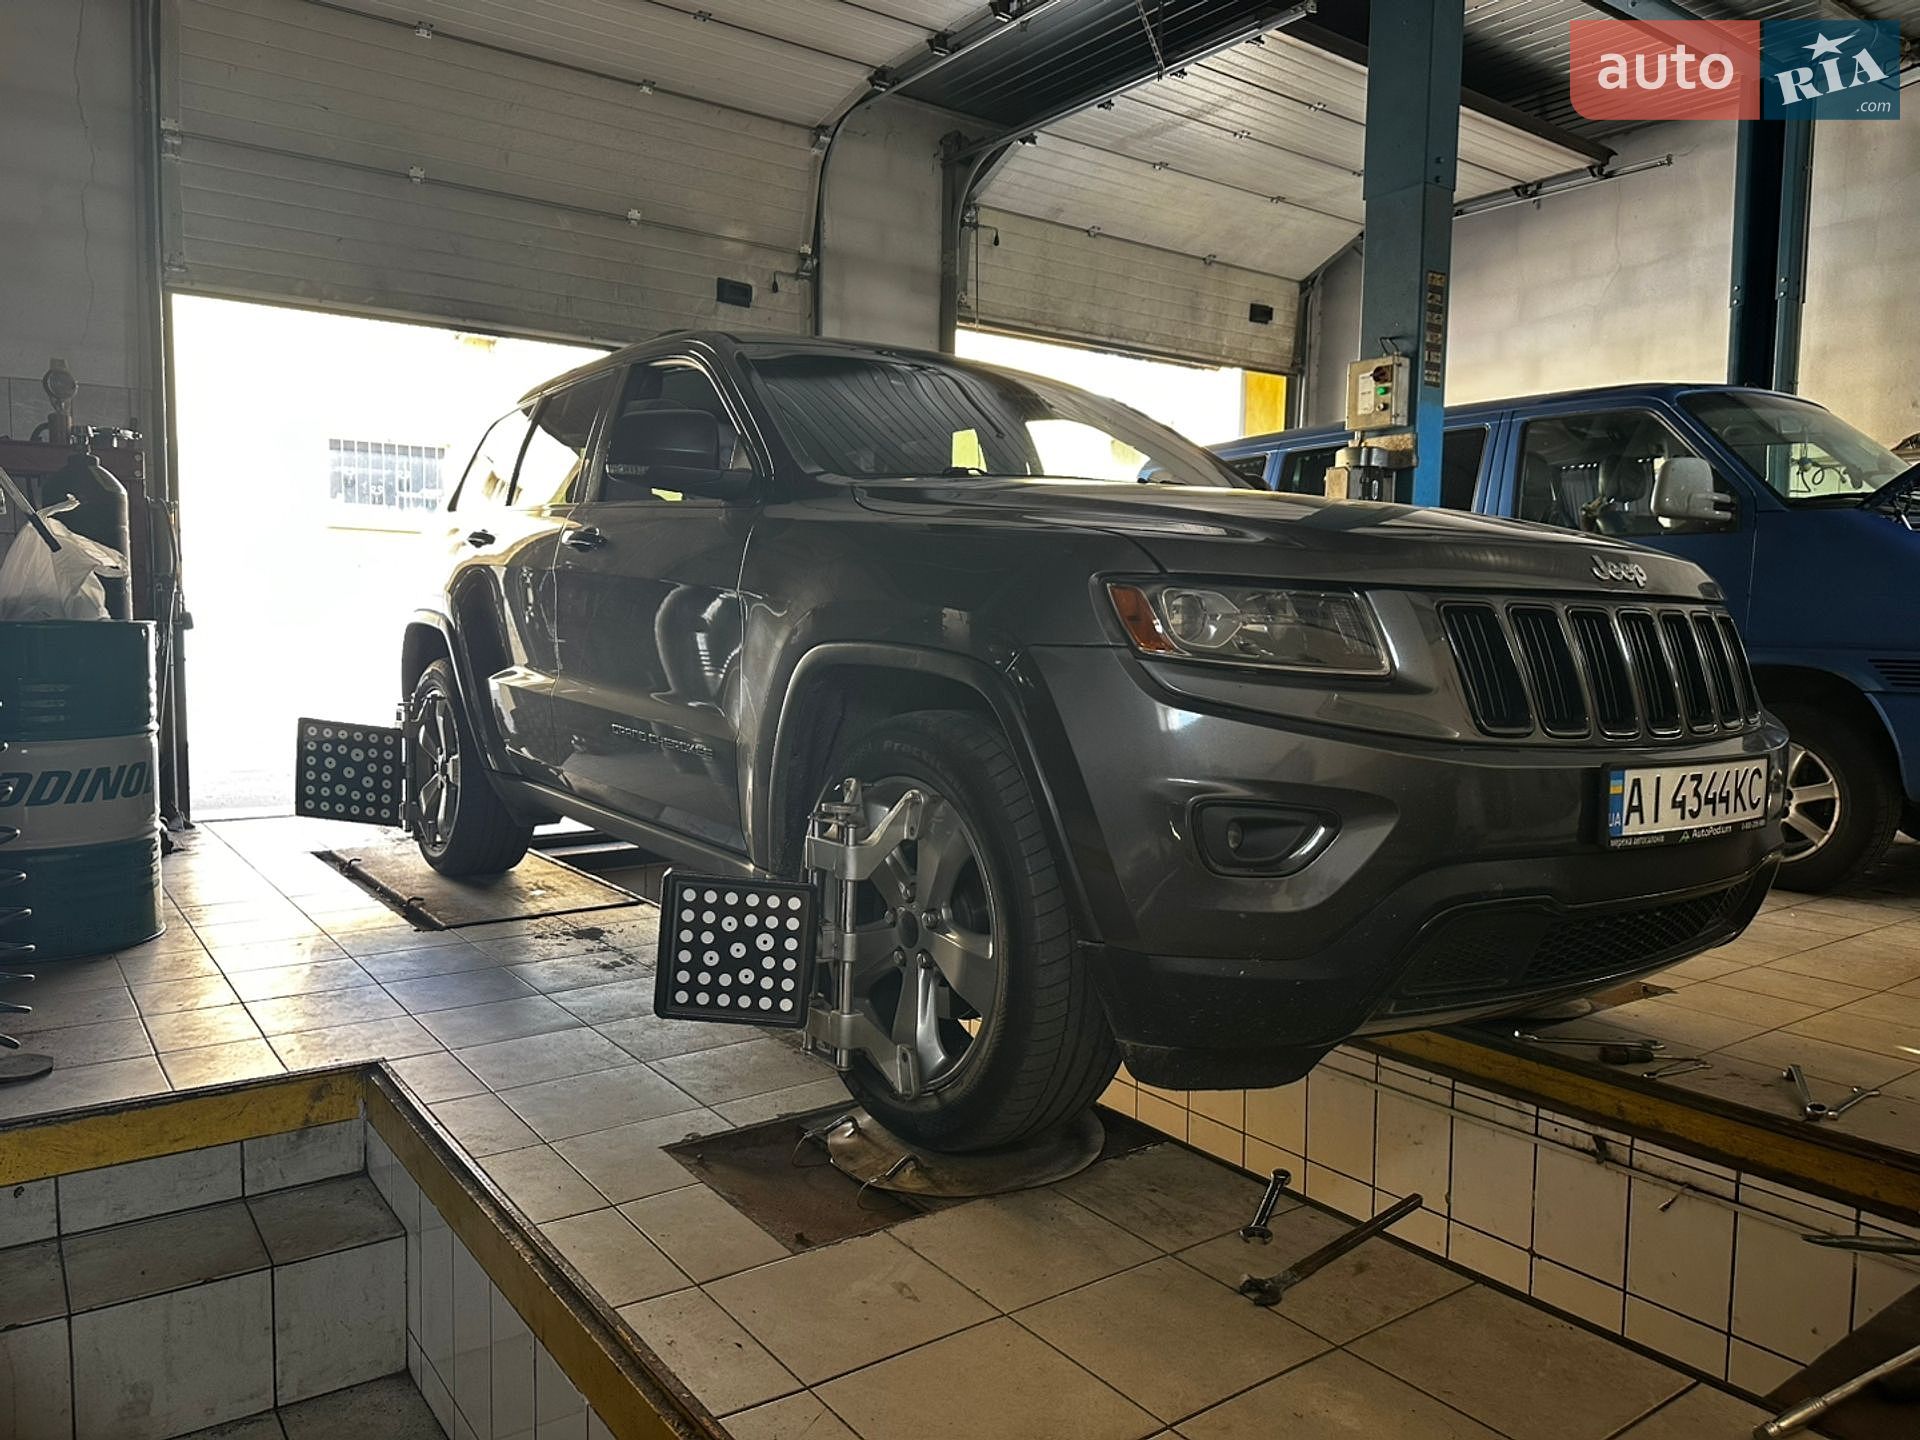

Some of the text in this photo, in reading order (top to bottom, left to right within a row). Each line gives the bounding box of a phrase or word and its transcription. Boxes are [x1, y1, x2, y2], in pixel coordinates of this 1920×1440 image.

[1591, 554, 1647, 587] Jeep
[1608, 812, 1621, 828] UA
[1692, 825, 1732, 839] AutoPodium
